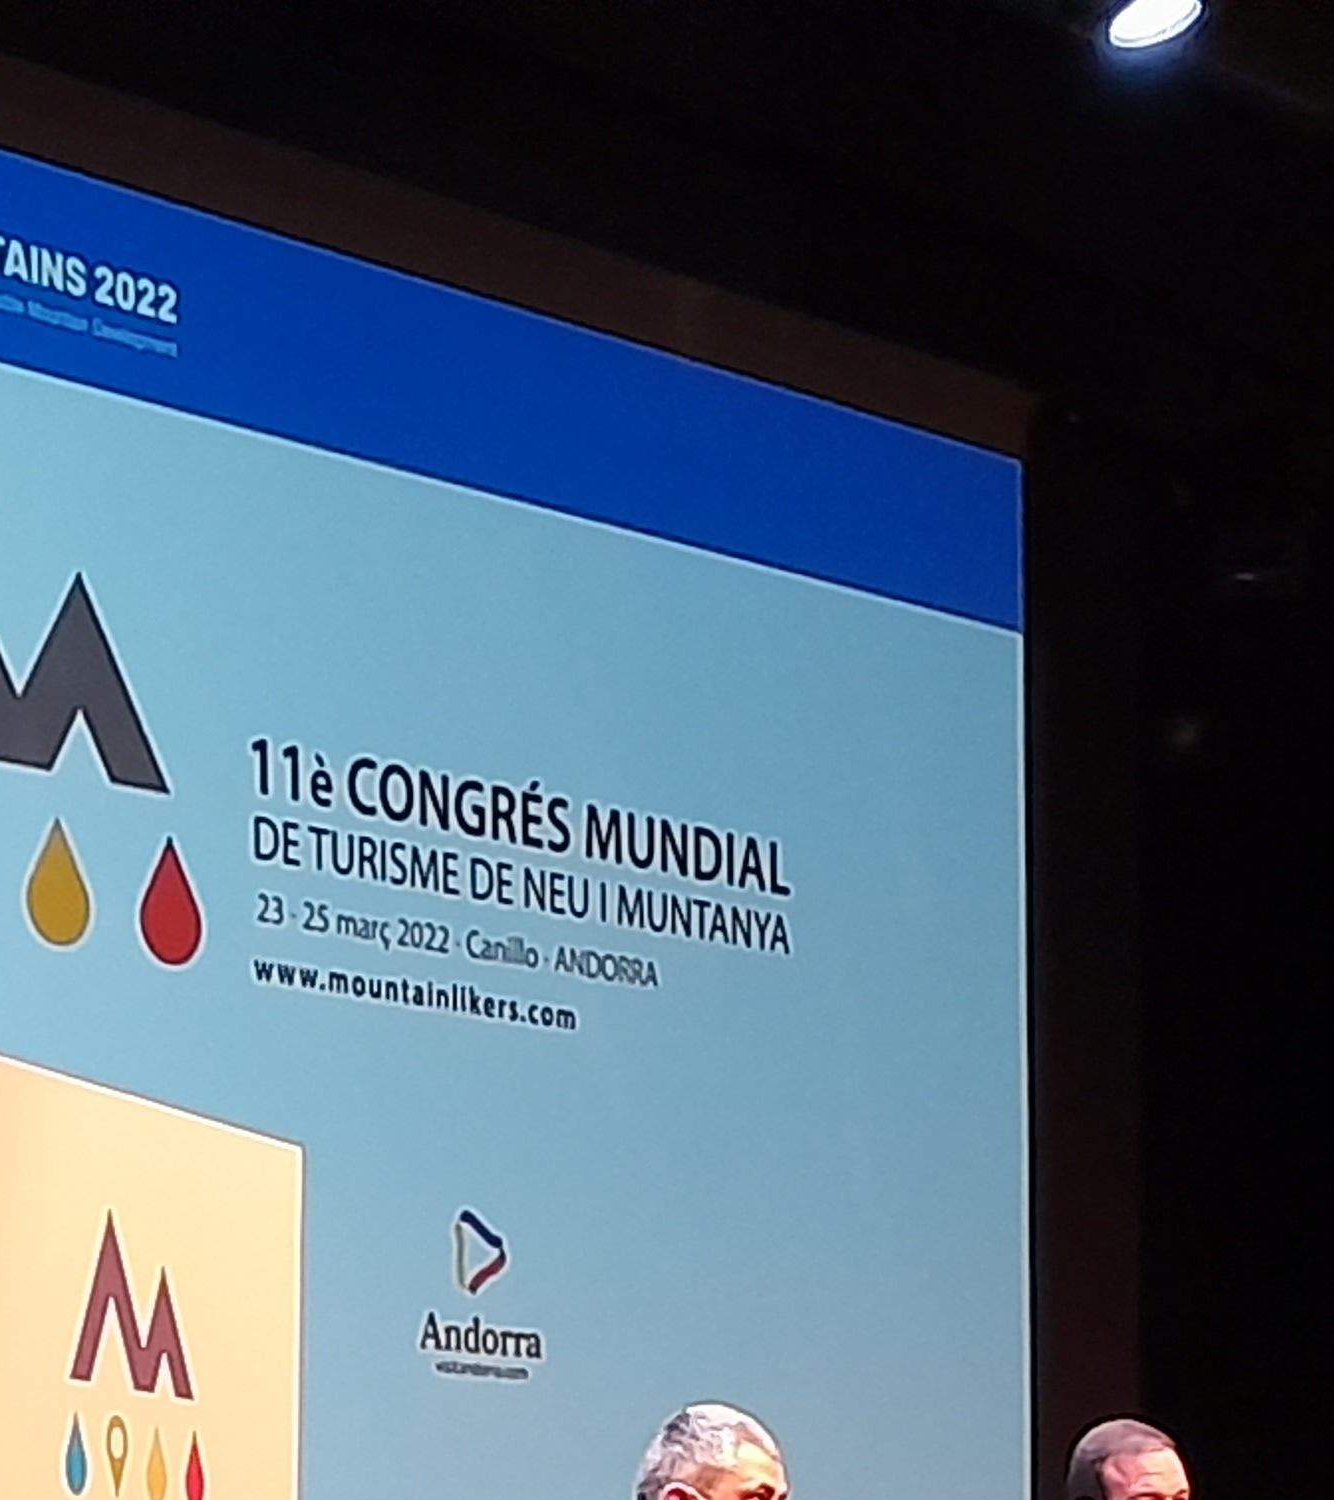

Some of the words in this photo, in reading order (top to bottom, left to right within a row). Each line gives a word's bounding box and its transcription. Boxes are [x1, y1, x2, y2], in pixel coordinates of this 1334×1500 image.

[94, 266, 178, 324] 2022
[251, 738, 333, 808] 11è
[347, 756, 572, 854] CONGRÉS
[585, 803, 792, 897] MUNDIAL
[252, 815, 301, 867] DE
[307, 825, 461, 896] TURISME
[469, 857, 514, 905] DE
[523, 866, 589, 919] NEU
[598, 881, 607, 923] I
[617, 884, 791, 955] MUNTANYA
[256, 892, 285, 925] 23
[301, 900, 331, 933] 25
[336, 912, 391, 951] març
[397, 917, 450, 954] 2022
[466, 929, 540, 968] Canillo
[553, 944, 659, 988] ANDORRA
[253, 958, 579, 1030] www.mountainlikers.com
[419, 1310, 543, 1360] Andorra
